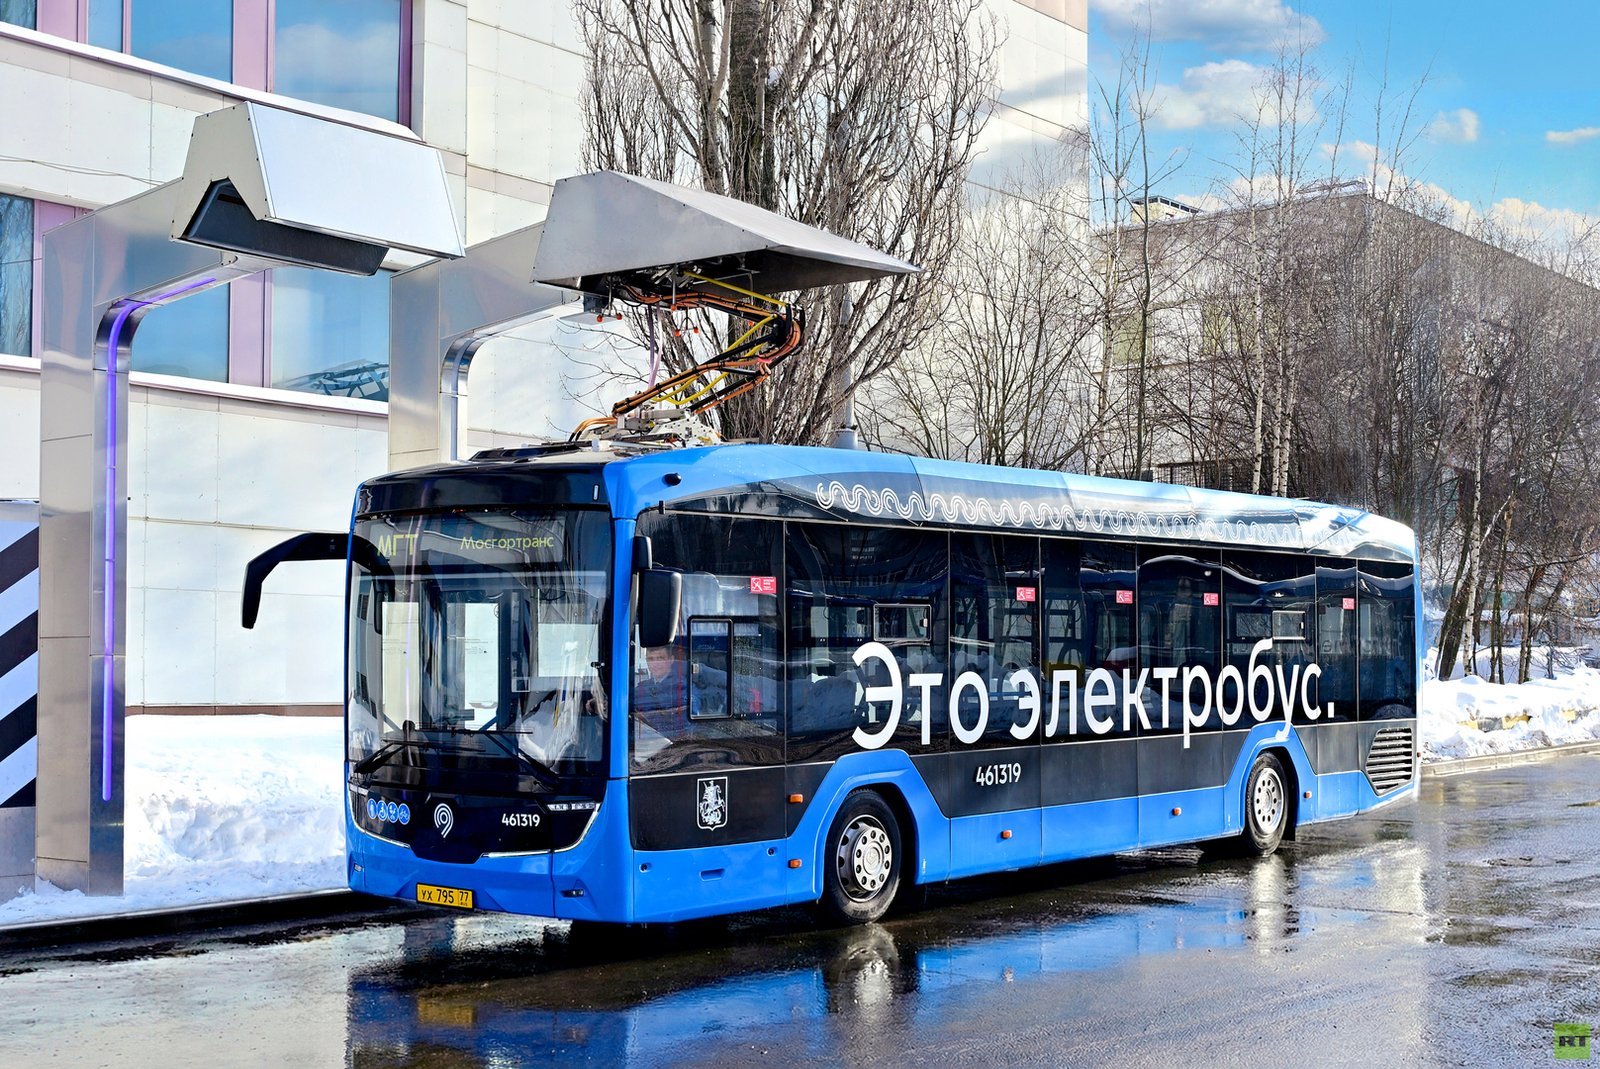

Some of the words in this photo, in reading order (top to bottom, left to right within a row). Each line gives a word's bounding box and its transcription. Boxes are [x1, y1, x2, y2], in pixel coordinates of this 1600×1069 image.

[377, 534, 419, 556] МГТ
[460, 536, 553, 551] Мосгортранс
[851, 642, 989, 749] Это
[1009, 638, 1334, 749] электробус.
[976, 763, 1021, 786] 461319
[502, 813, 540, 827] 461319
[436, 889, 454, 904] 795
[459, 891, 469, 902] 77
